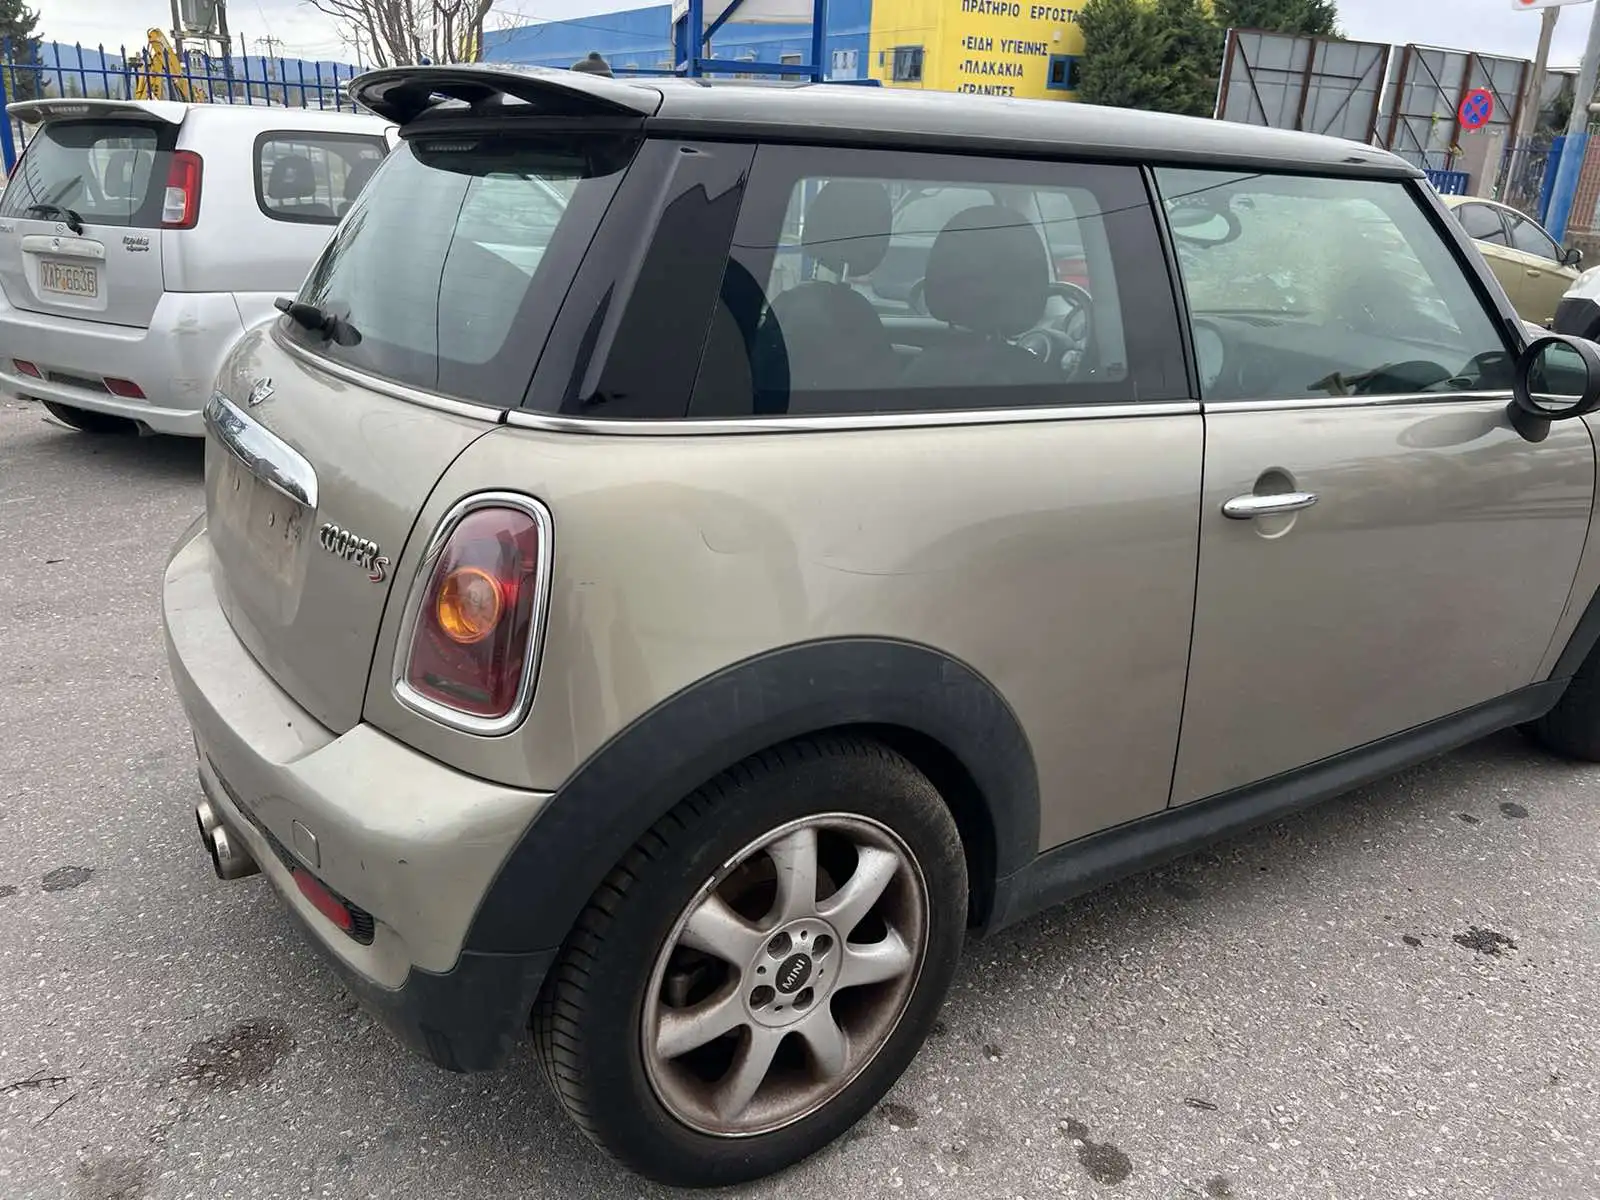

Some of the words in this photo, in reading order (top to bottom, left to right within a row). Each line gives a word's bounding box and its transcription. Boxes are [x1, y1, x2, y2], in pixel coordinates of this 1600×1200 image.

[962, 0, 1020, 17] ΠΡΑΤΗΡΙΟ
[967, 36, 993, 51] ΕΙΔΗ
[1000, 38, 1048, 56] ΥΓΙΕΙΝΗΣ
[965, 60, 1023, 77] ΠΛΑΚΑΚΙΑ
[319, 523, 378, 570] COOPER
[368, 556, 391, 583] S
[782, 959, 806, 989] MINI
